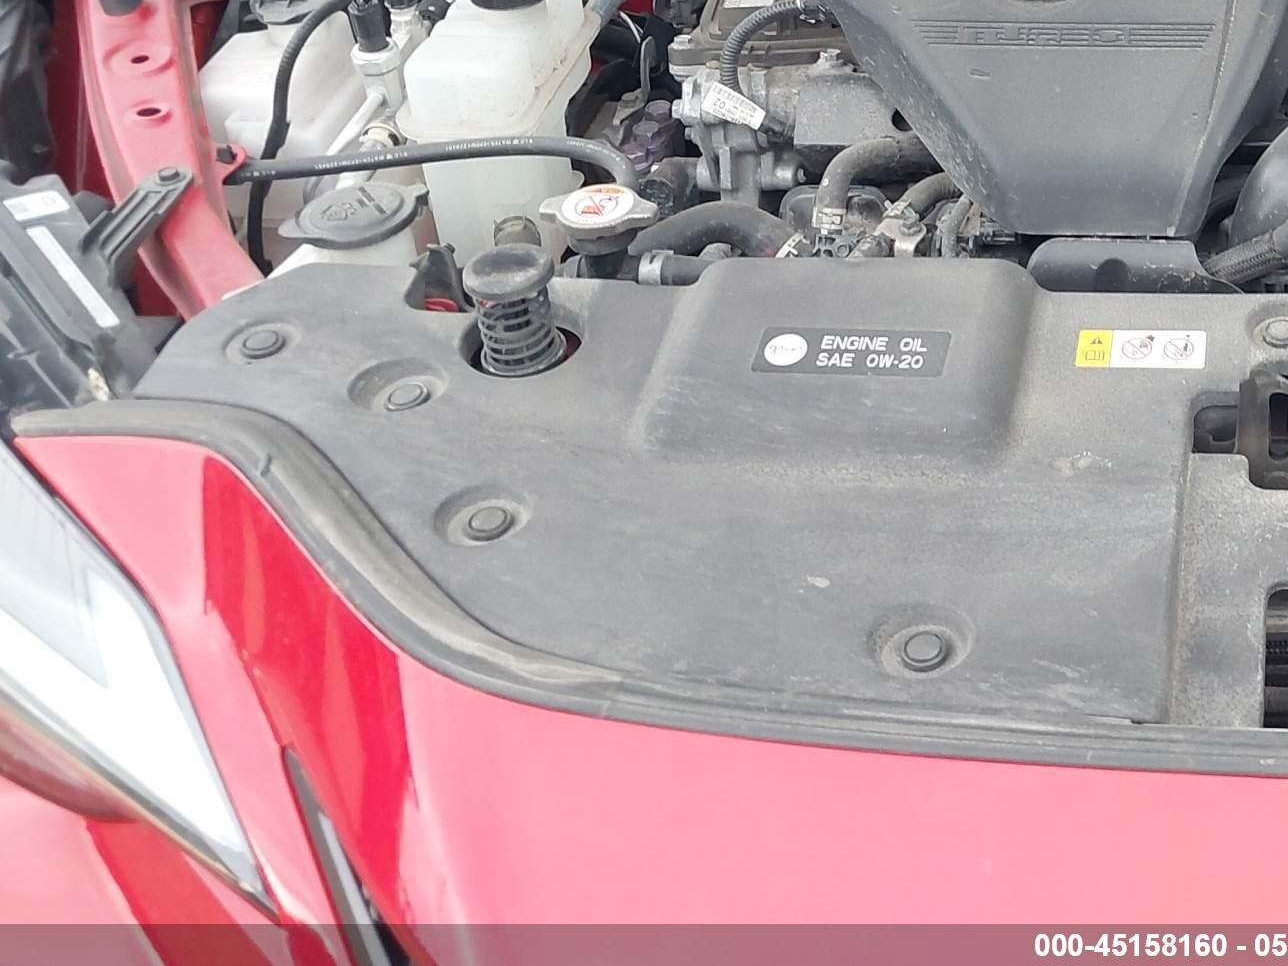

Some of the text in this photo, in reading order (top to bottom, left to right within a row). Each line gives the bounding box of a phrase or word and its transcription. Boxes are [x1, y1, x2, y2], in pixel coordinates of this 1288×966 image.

[961, 26, 1127, 45] TURBO
[820, 335, 889, 351] ENGINE
[900, 337, 928, 352] OIL
[816, 352, 924, 369] SAE 0W-20
